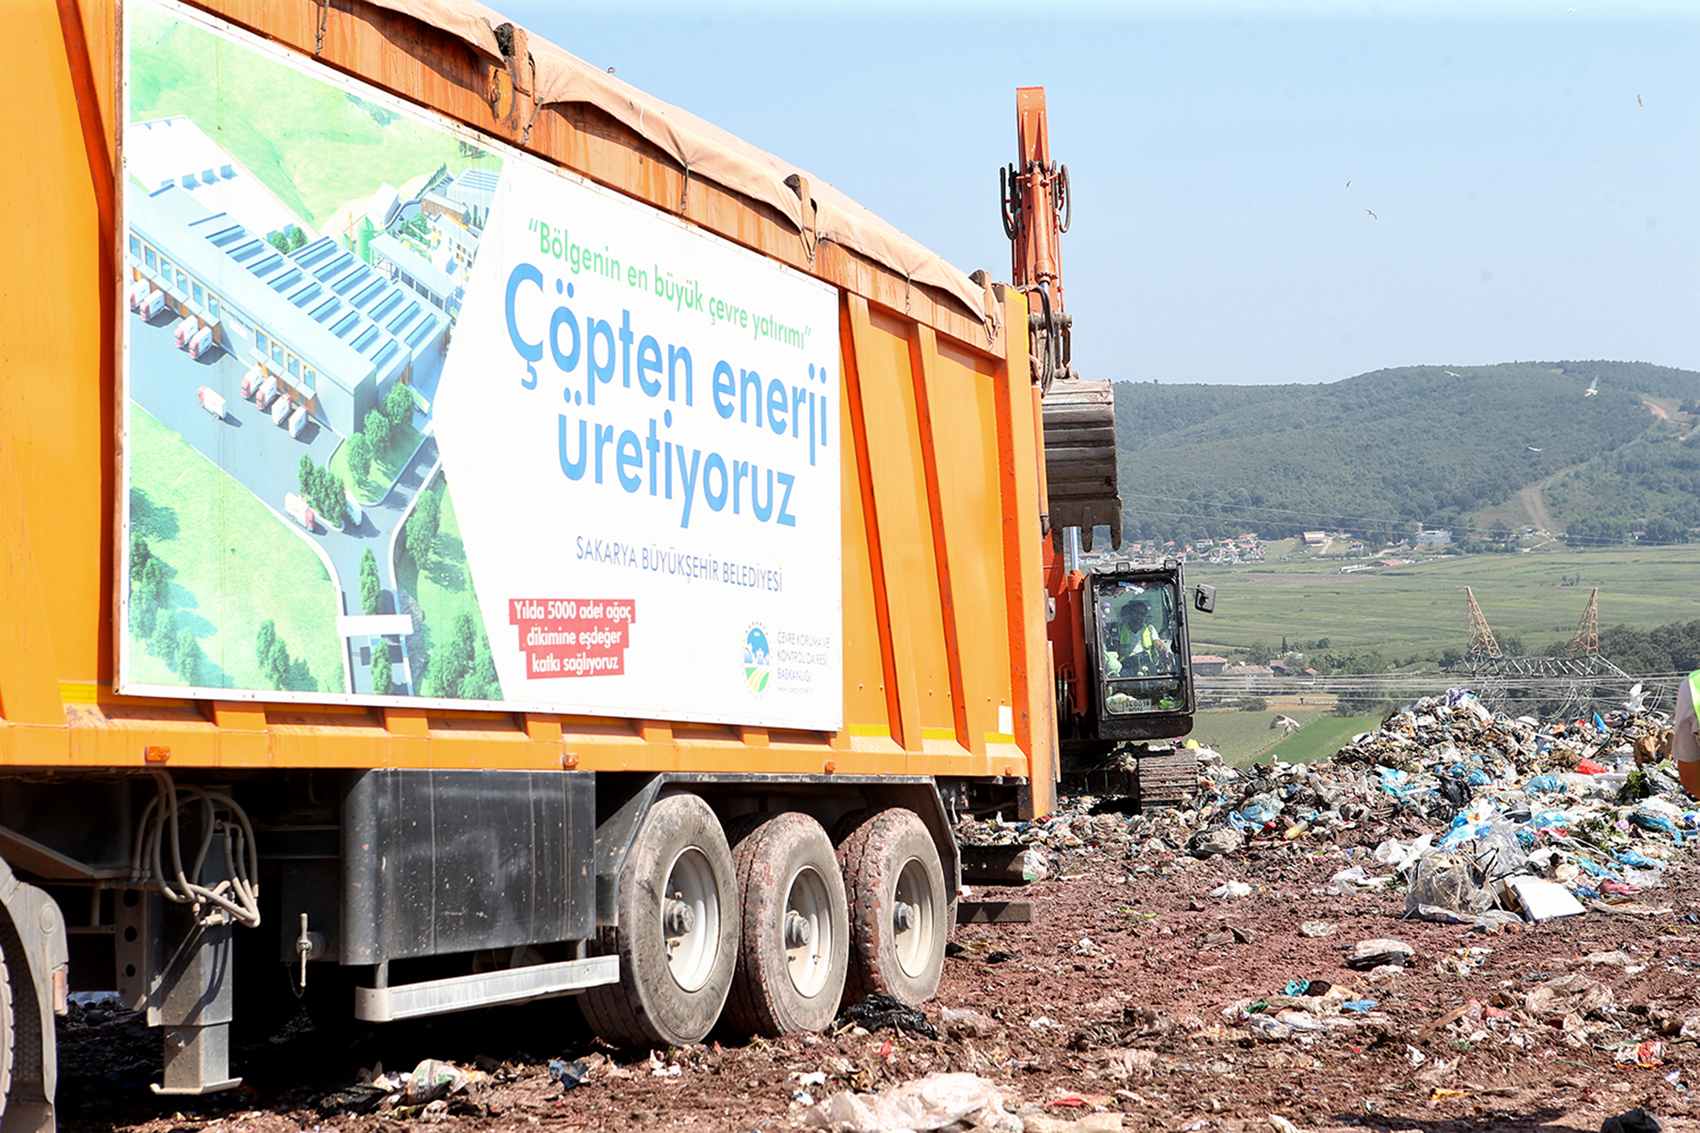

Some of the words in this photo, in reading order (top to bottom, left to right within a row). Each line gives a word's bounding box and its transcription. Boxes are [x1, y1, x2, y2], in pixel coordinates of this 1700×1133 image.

[627, 266, 648, 291] en
[654, 264, 703, 312] büyük
[708, 294, 748, 329] çevre
[505, 262, 693, 407] Çöpten
[712, 360, 827, 467] enerji
[558, 387, 796, 529] üretiyoruz
[576, 535, 638, 568] SAKARYA
[642, 543, 720, 584] BÜYÜKŞEHİR
[723, 561, 782, 592] BELEDİYESİ
[513, 600, 545, 620] Yılda
[547, 600, 577, 620] 5000
[579, 600, 604, 619] adet
[606, 601, 632, 624] ağaç
[526, 626, 577, 646] dikimine
[578, 625, 622, 650] eşdeğer
[532, 652, 561, 672] katkı
[563, 651, 619, 675] sağlıyoruz
